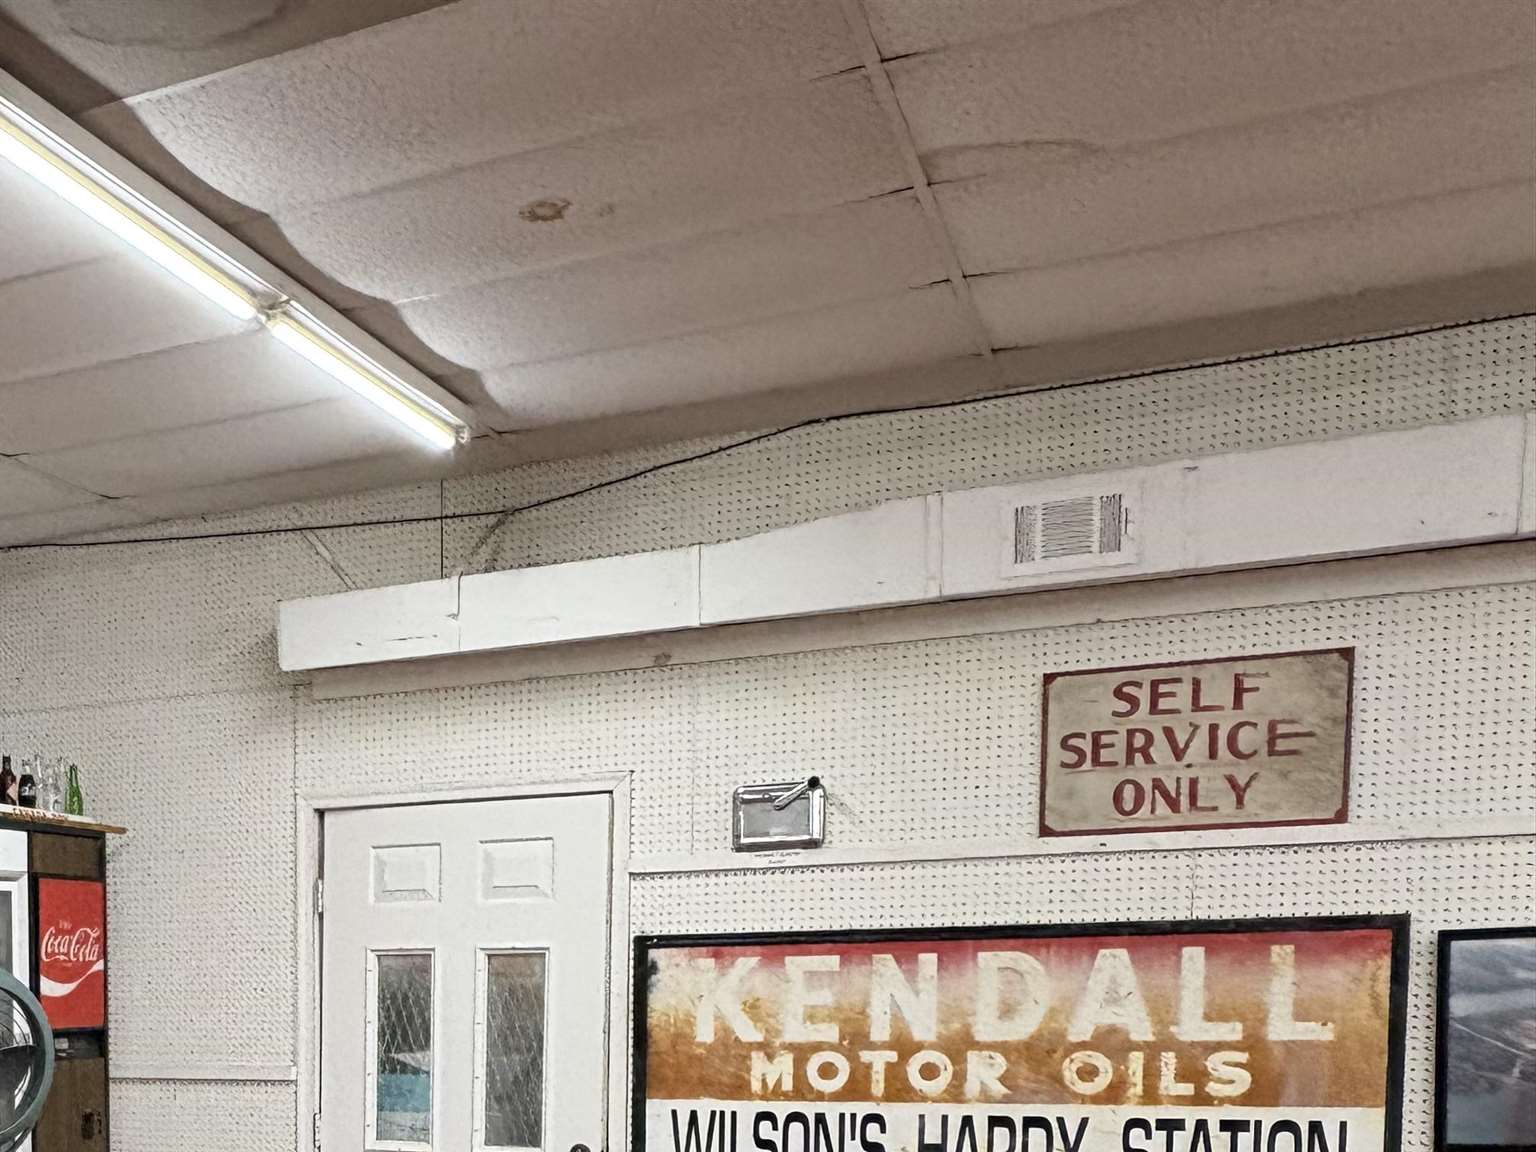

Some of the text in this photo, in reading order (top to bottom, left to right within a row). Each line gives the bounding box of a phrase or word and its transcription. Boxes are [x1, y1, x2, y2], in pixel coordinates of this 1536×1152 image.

[1112, 672, 1270, 718] SELF
[1060, 719, 1316, 769] SERVICE
[1112, 772, 1259, 817] ONLY
[693, 945, 1335, 1046] KENDALL
[750, 1050, 1252, 1099] MOTOR OILS
